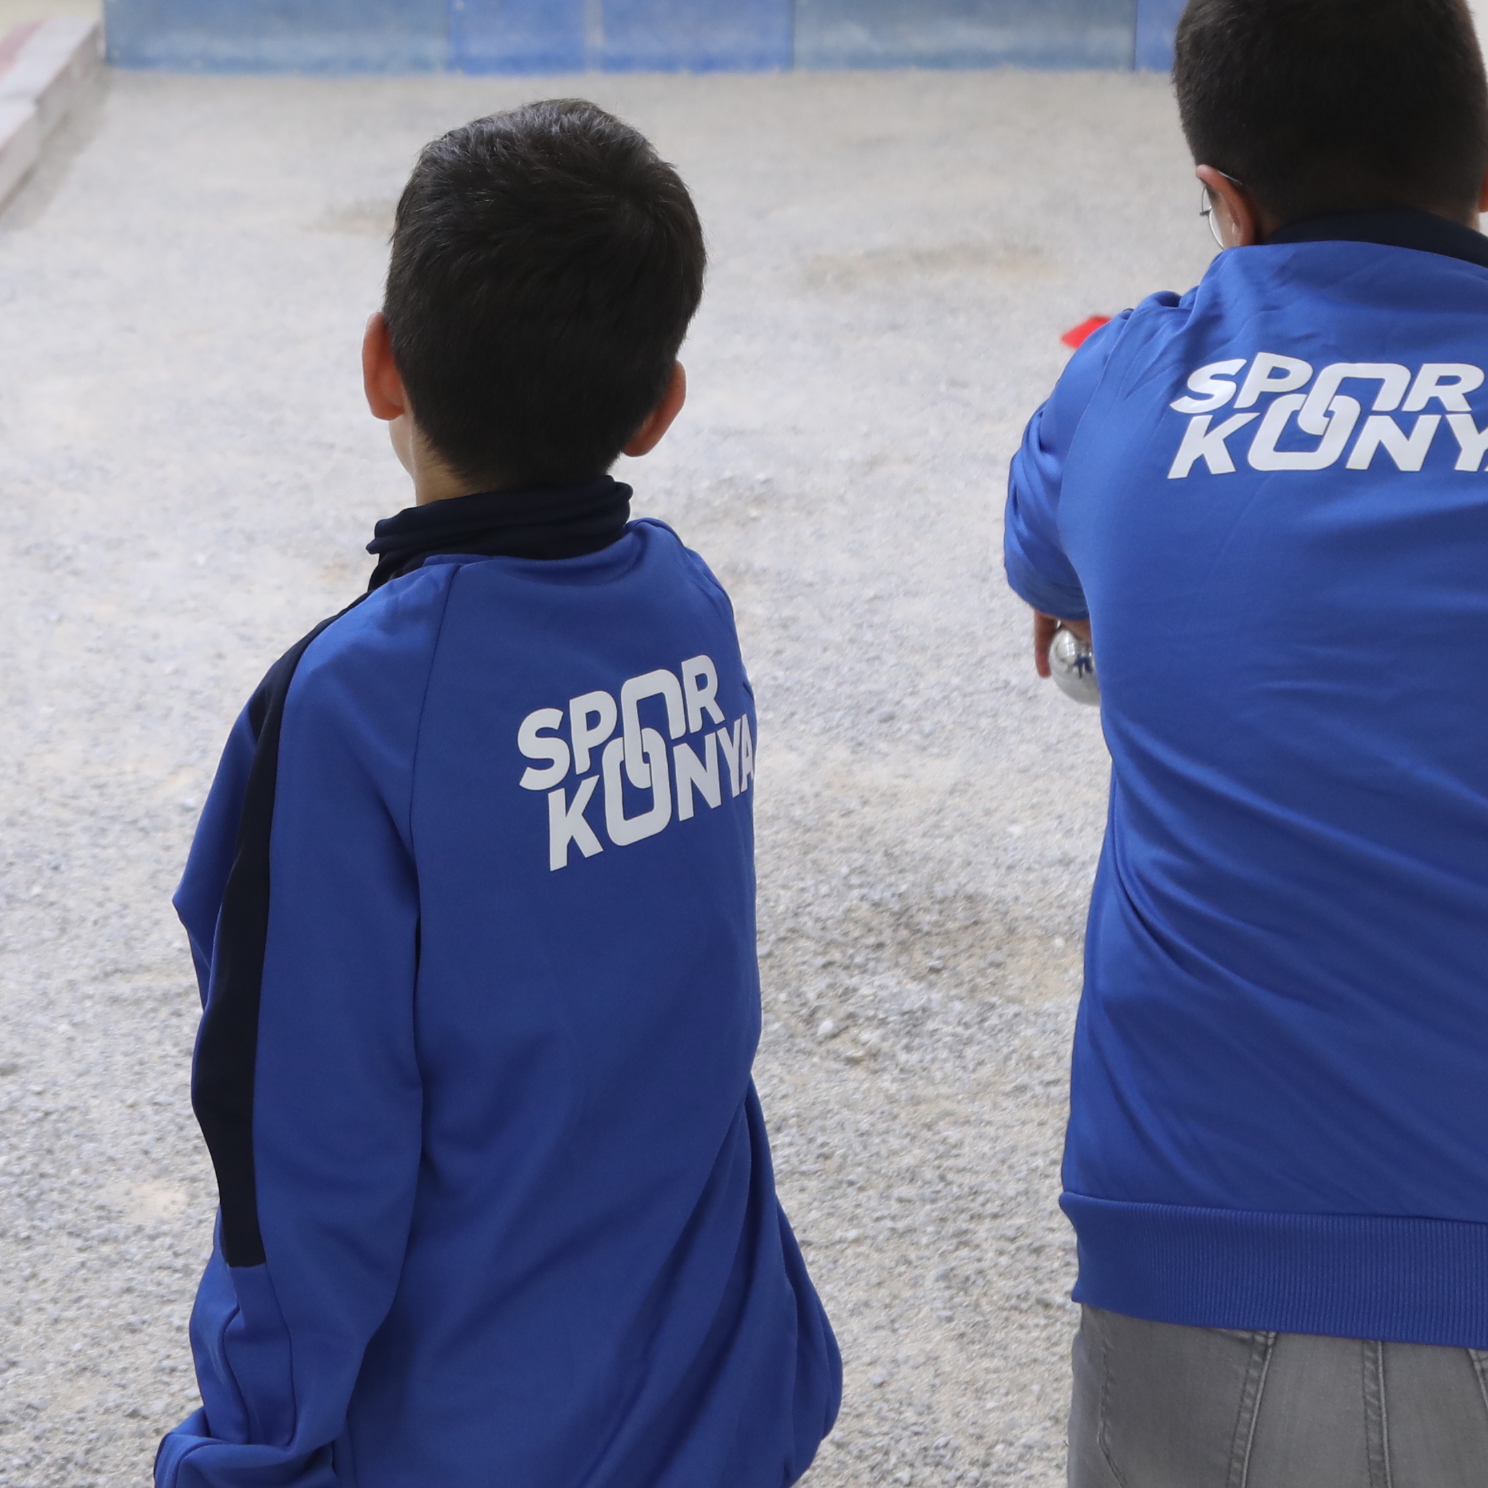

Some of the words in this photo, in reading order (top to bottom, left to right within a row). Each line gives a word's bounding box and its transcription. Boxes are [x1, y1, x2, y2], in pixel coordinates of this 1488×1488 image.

[1170, 352, 1485, 435] SPOR
[517, 654, 726, 791] SPOR
[548, 714, 754, 872] KONYA
